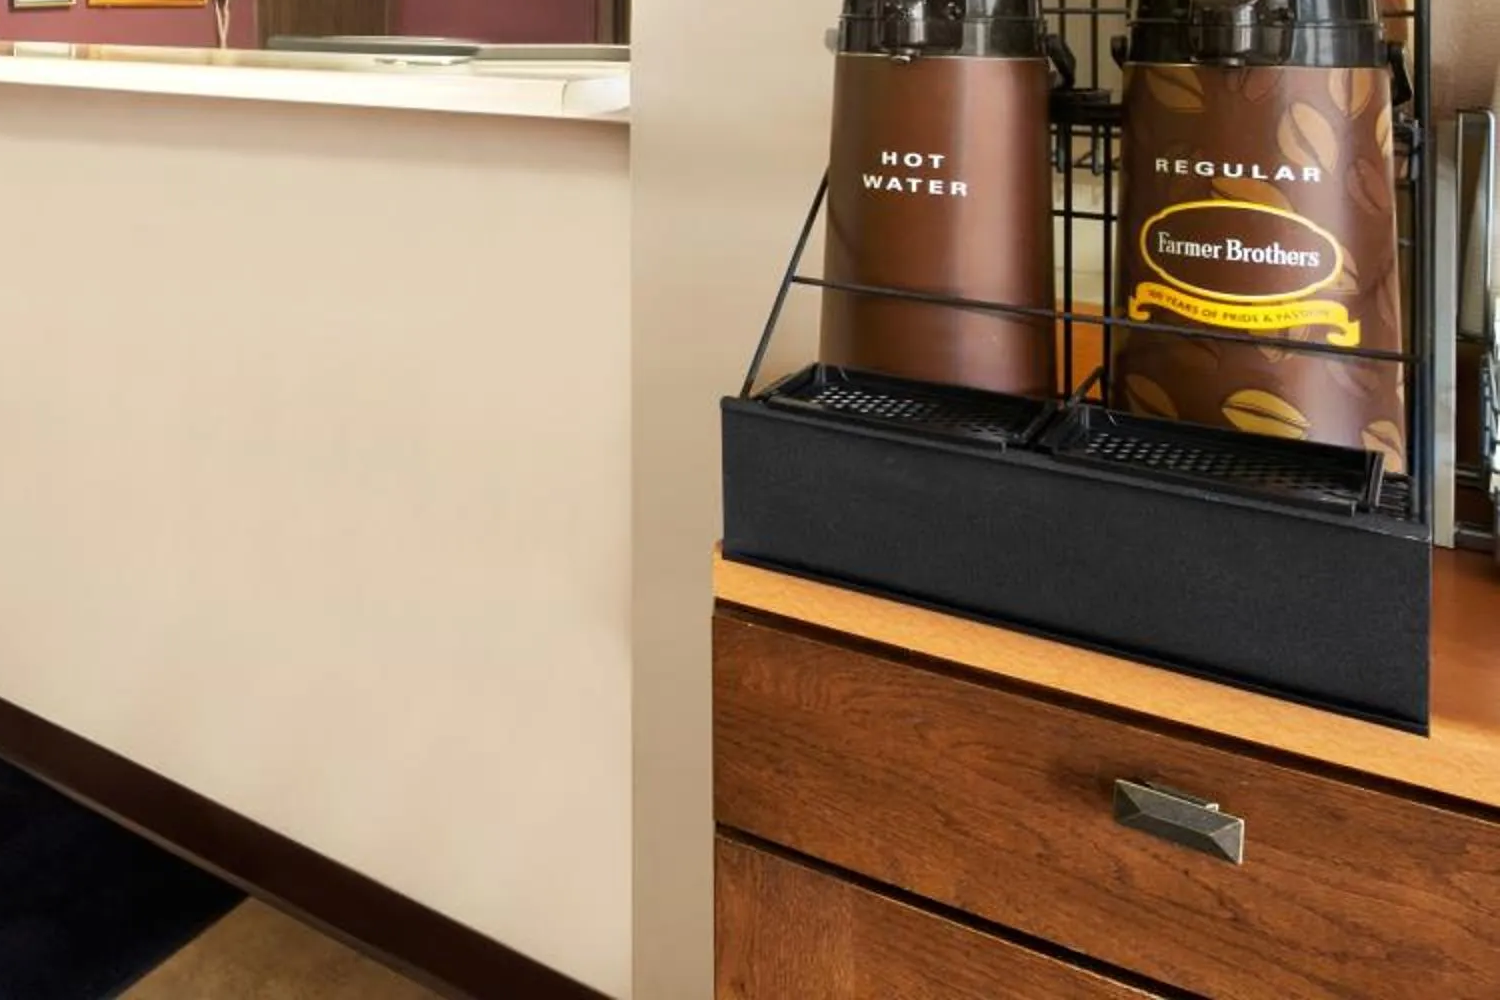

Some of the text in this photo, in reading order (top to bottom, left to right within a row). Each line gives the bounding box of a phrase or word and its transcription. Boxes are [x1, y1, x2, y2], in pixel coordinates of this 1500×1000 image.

[881, 151, 946, 169] HOT
[1155, 157, 1322, 183] REGULAR
[863, 173, 969, 198] WATER
[1156, 230, 1321, 268] Farmer Brothers
[1166, 295, 1199, 315] YEARS
[1201, 308, 1218, 318] OF
[1222, 310, 1259, 323] PRIDE
